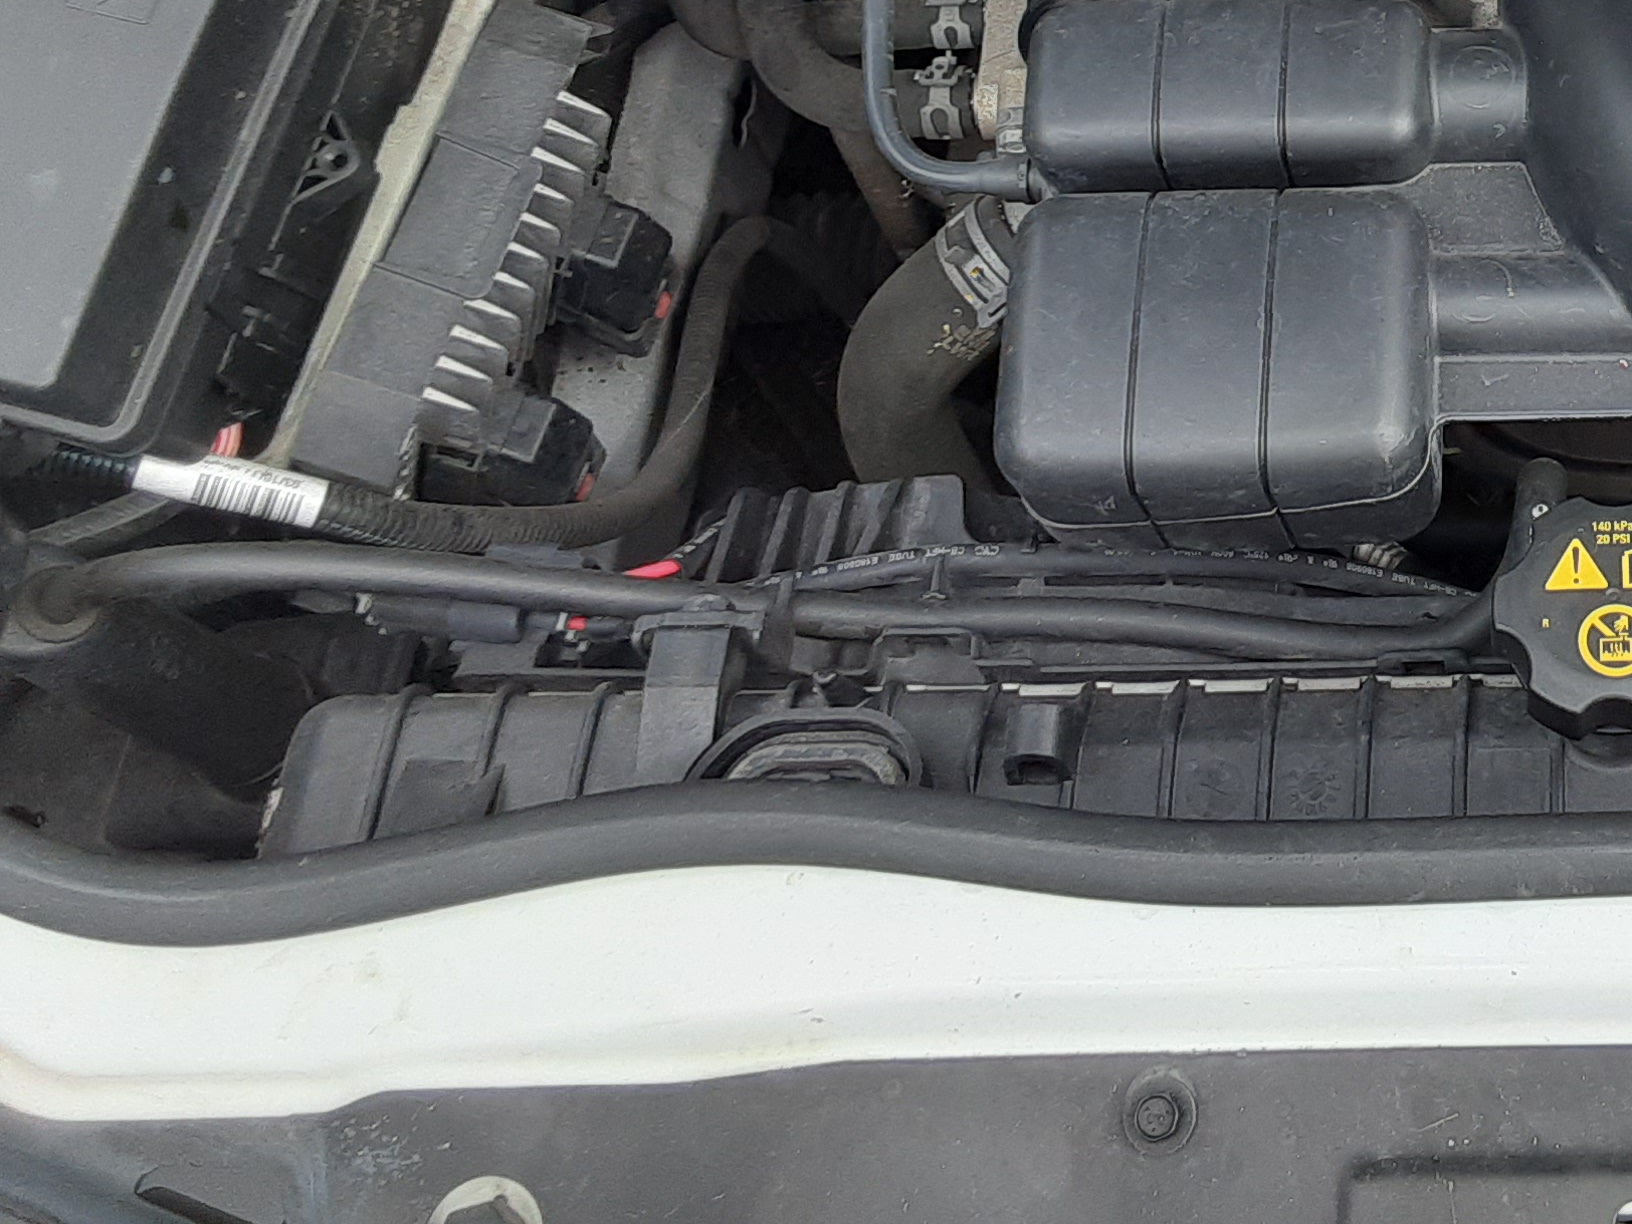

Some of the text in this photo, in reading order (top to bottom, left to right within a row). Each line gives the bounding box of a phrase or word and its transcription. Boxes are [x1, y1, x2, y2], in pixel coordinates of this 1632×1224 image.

[1591, 521, 1612, 532] 140
[1596, 534, 1631, 545] 20 PSI
